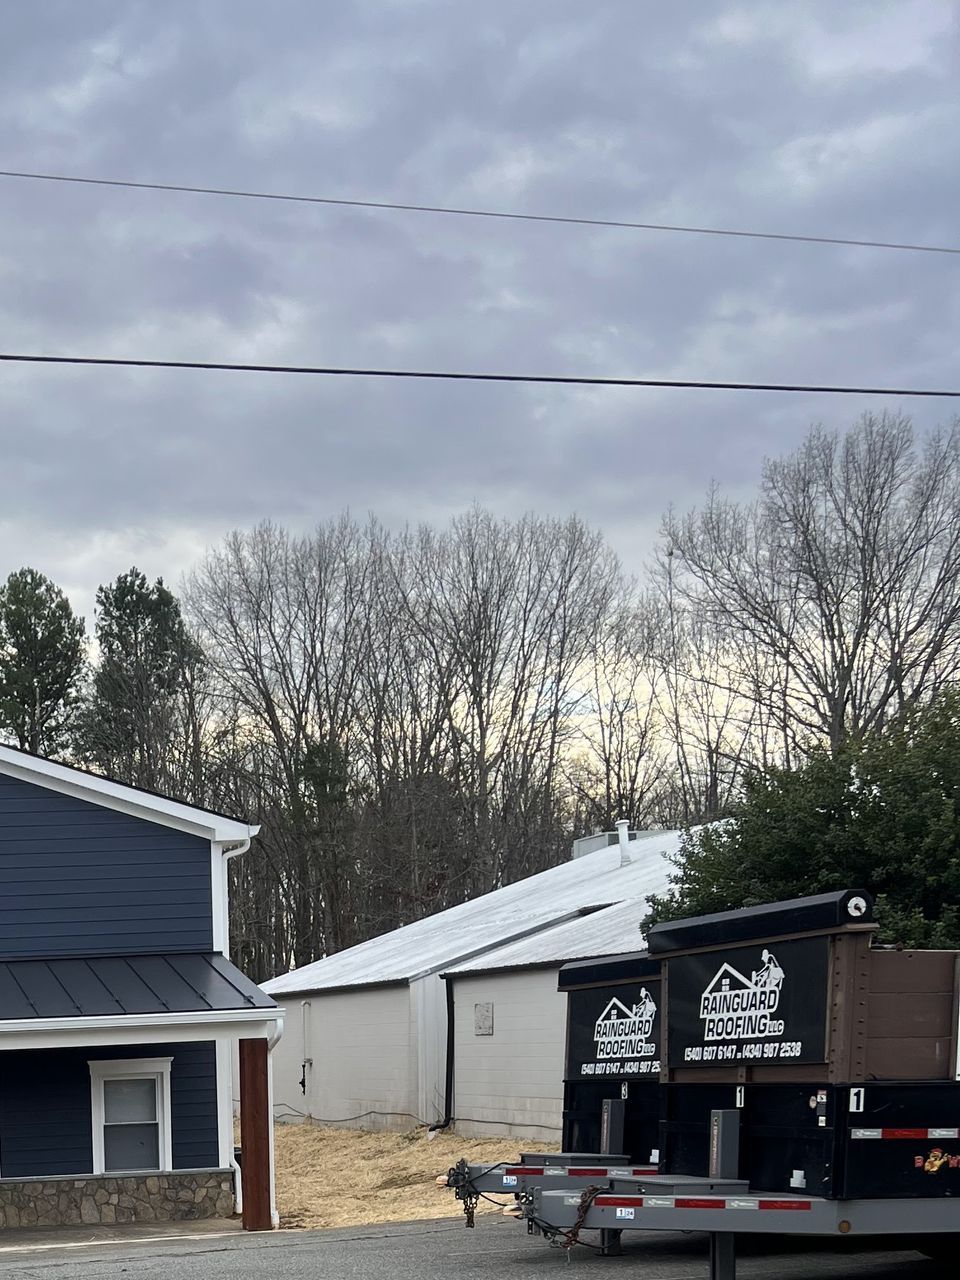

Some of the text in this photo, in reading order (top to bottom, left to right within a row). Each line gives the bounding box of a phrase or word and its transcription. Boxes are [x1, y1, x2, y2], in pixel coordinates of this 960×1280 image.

[702, 989, 777, 1015] RAINGUARD
[595, 1019, 651, 1038] RAINGUARD
[706, 1014, 784, 1038] ROOFING LLC
[598, 1039, 643, 1056] ROOFING
[684, 1047, 702, 1061] (540)
[703, 1046, 717, 1060] 607
[718, 1045, 736, 1059] 6147
[742, 1043, 762, 1059] (434)
[763, 1043, 779, 1058] 987
[780, 1042, 801, 1057] 2538
[853, 1089, 862, 1111] 1
